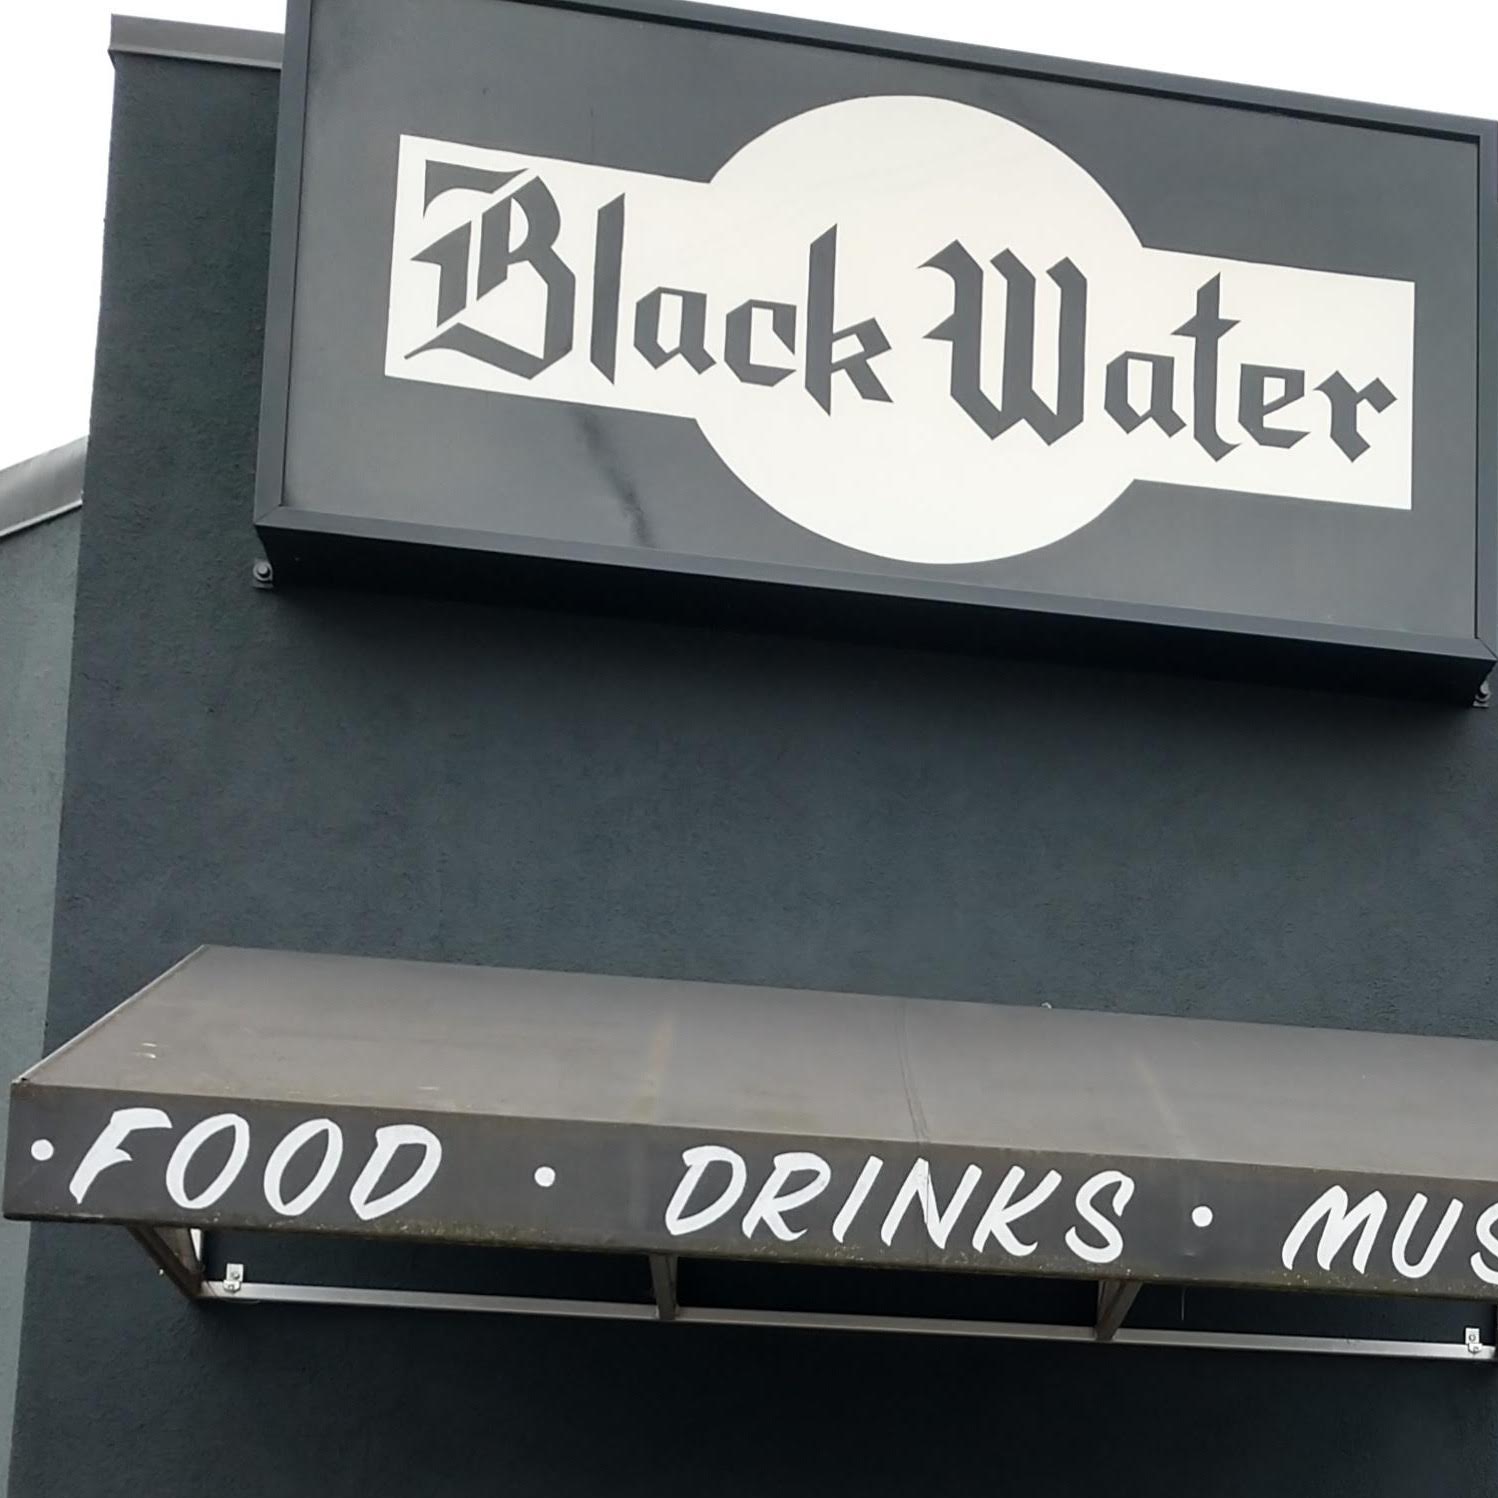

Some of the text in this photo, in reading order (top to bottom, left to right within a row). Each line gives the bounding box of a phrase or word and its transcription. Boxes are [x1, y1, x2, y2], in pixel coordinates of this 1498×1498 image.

[404, 158, 1397, 463] Black Water
[69, 1107, 443, 1221] FOOD
[665, 1145, 1135, 1264] DRINKS
